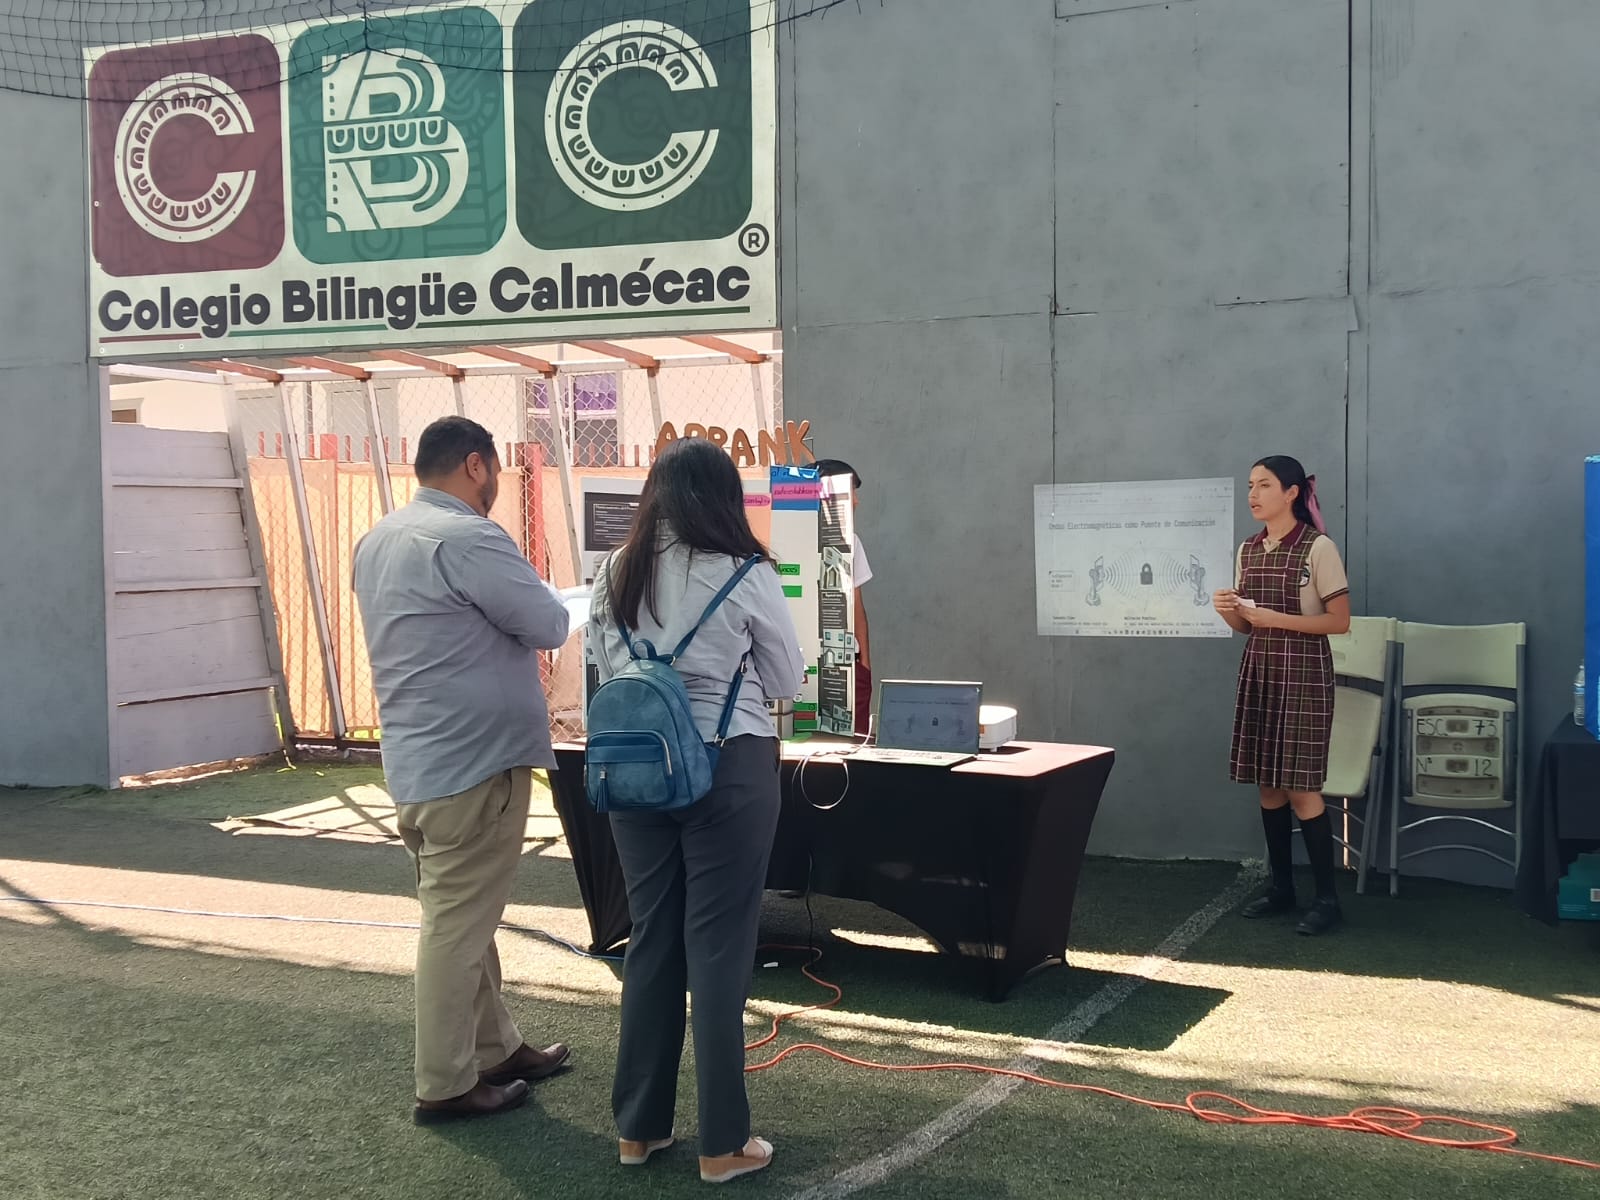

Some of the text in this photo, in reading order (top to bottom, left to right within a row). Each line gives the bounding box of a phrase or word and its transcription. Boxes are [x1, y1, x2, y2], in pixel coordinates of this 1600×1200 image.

[99, 257, 751, 339] Colegio Bilingüe Calmécac
[1475, 758, 1493, 777] 12
